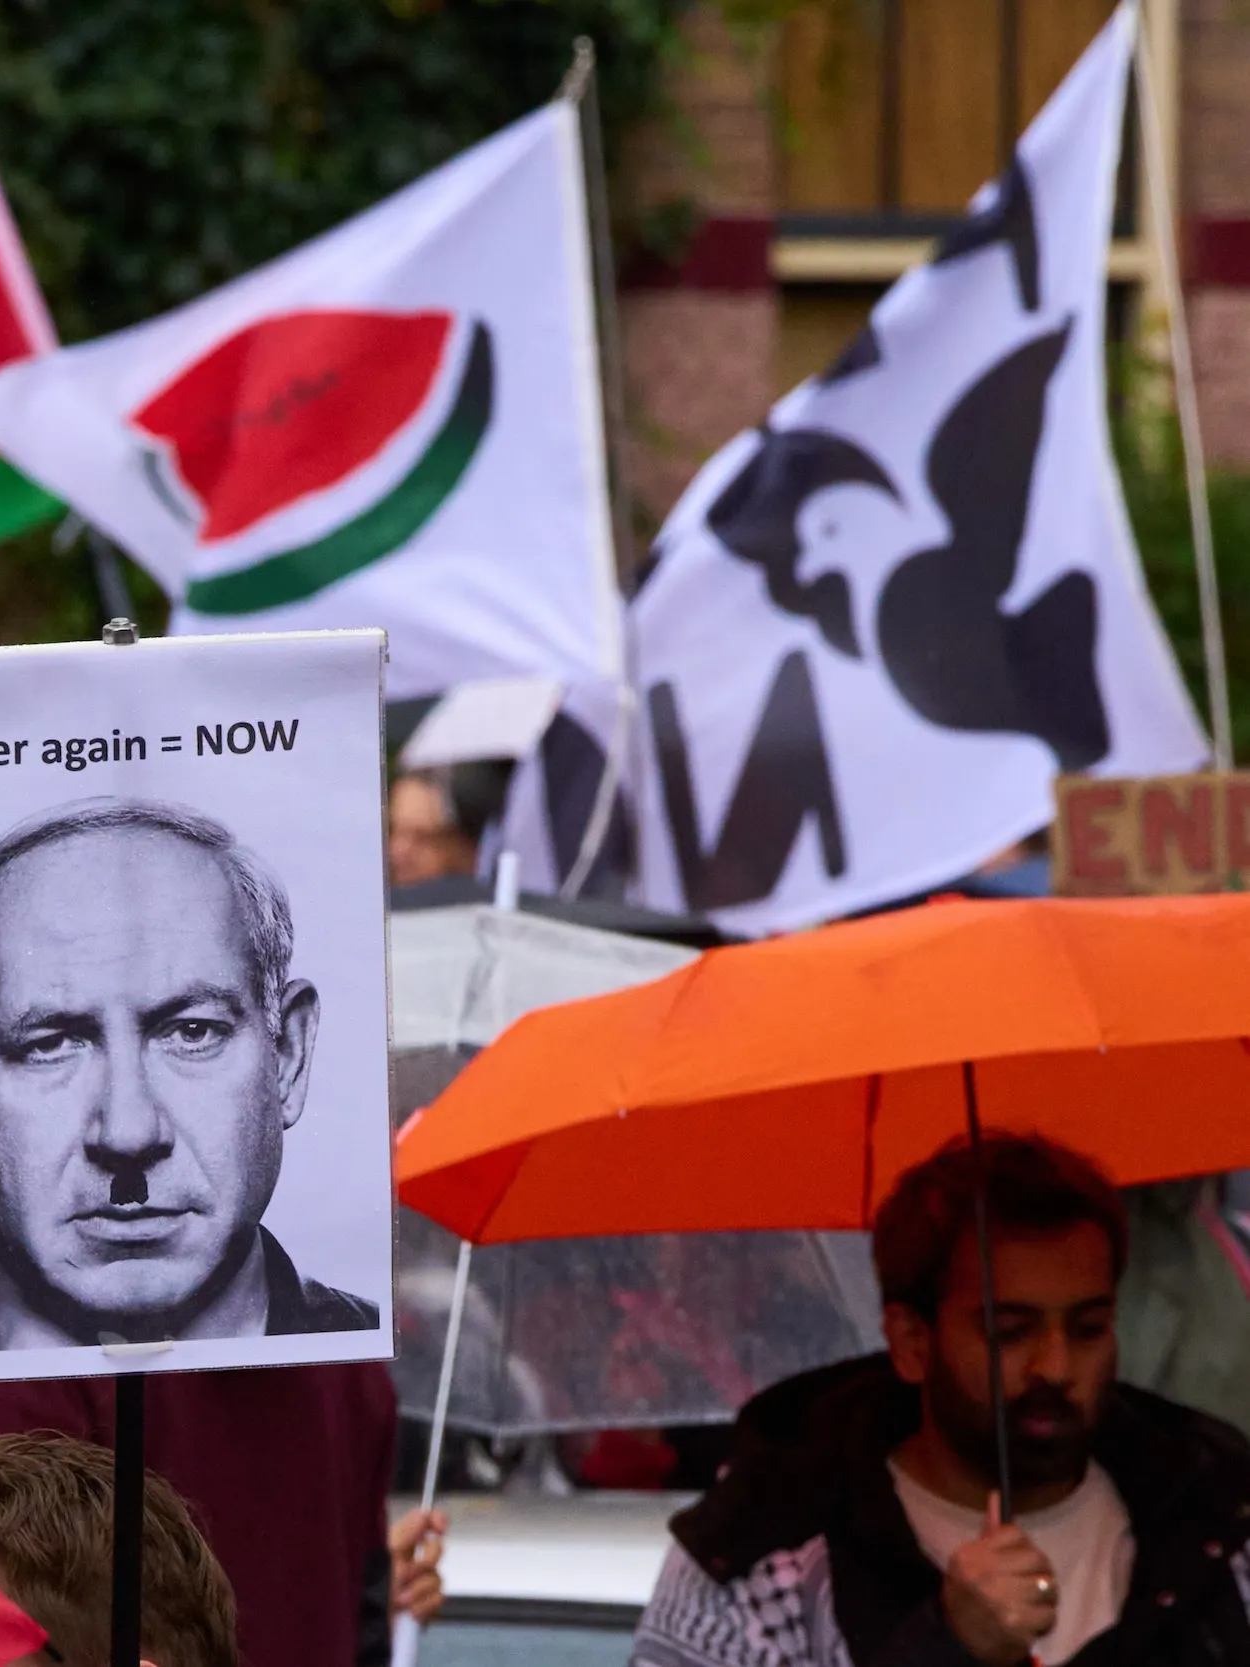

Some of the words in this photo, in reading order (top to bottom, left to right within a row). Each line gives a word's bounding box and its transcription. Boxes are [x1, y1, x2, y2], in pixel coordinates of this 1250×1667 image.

[41, 728, 147, 771] again
[160, 734, 182, 753] =
[196, 718, 300, 757] NOW
